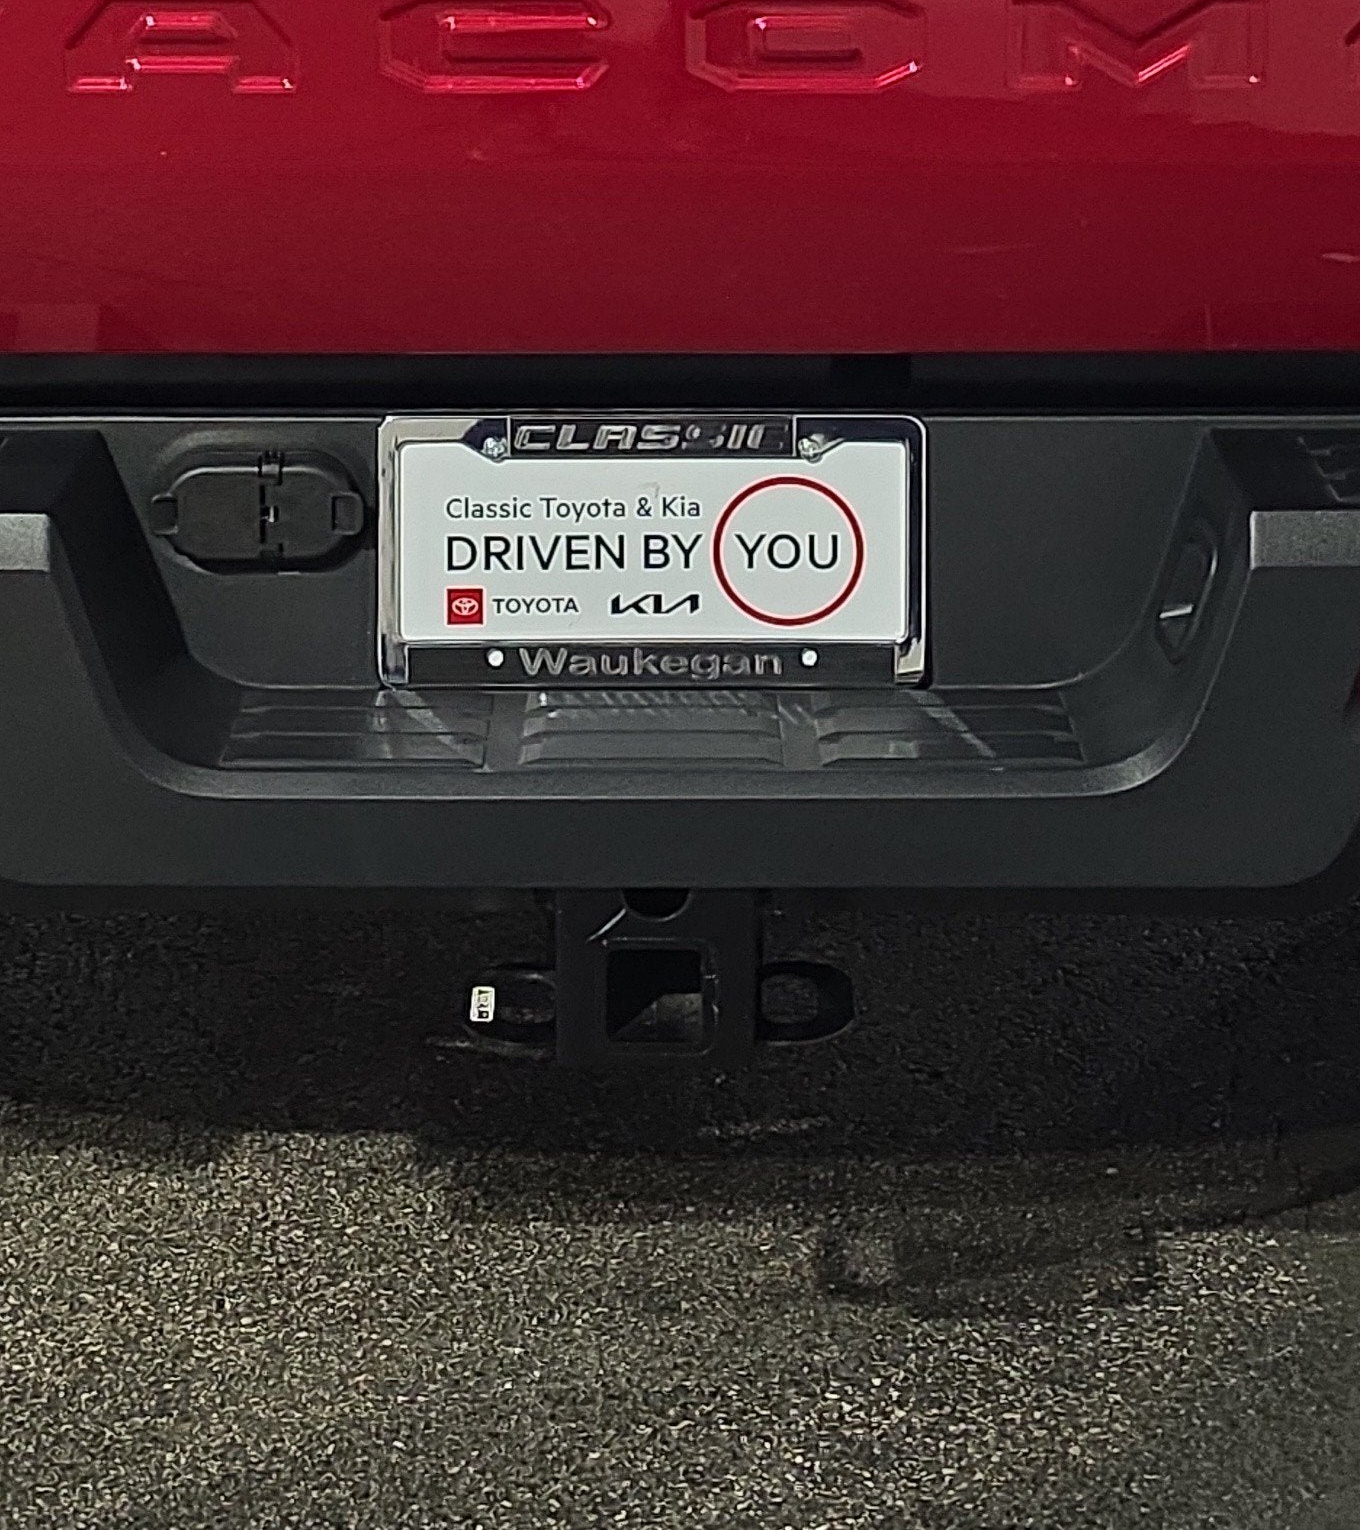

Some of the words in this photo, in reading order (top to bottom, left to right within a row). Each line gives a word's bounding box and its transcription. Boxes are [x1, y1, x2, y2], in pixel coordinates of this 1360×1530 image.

[446, 497, 532, 519] Classic
[540, 497, 626, 523] Toyota
[636, 496, 653, 518] &
[662, 495, 701, 518] Kia
[446, 535, 625, 571] DRIVEN
[643, 534, 703, 569] BY
[735, 533, 840, 570] YOU
[492, 597, 579, 614] TOYOTA
[518, 647, 782, 679] Waukegan
